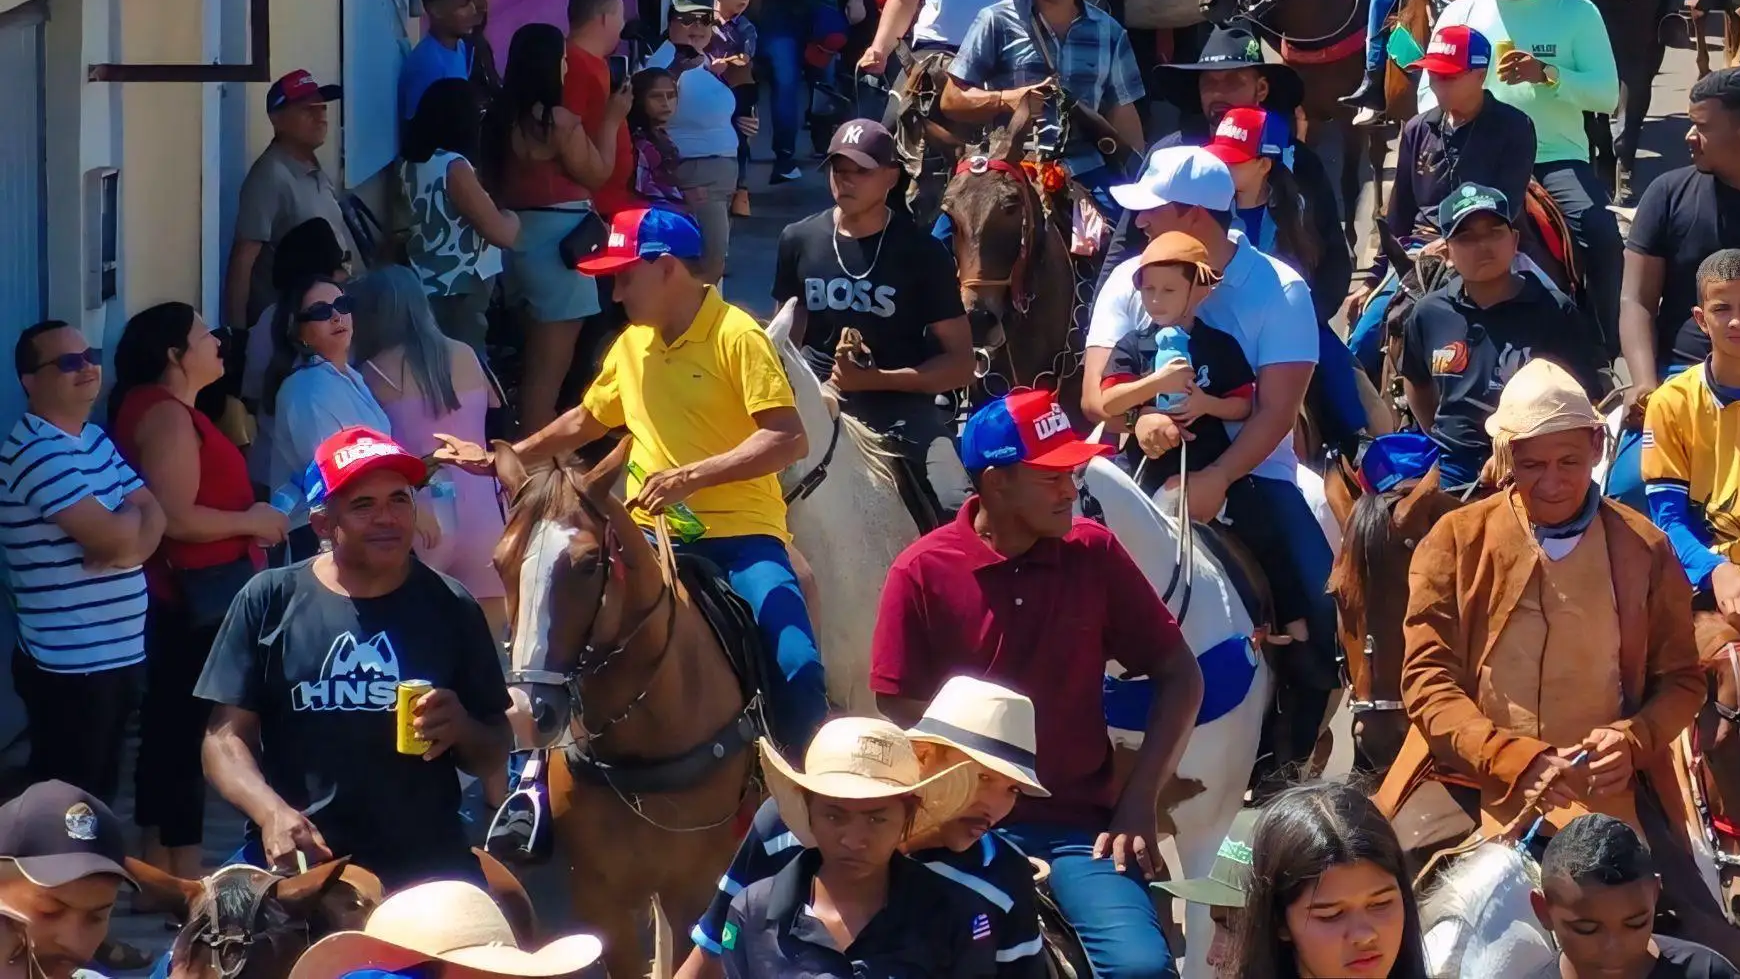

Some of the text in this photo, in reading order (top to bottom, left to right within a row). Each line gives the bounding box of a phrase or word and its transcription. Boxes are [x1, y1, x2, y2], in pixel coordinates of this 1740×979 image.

[842, 125, 865, 145] NY
[805, 277, 896, 318] BOSS
[299, 680, 398, 708] HNS
